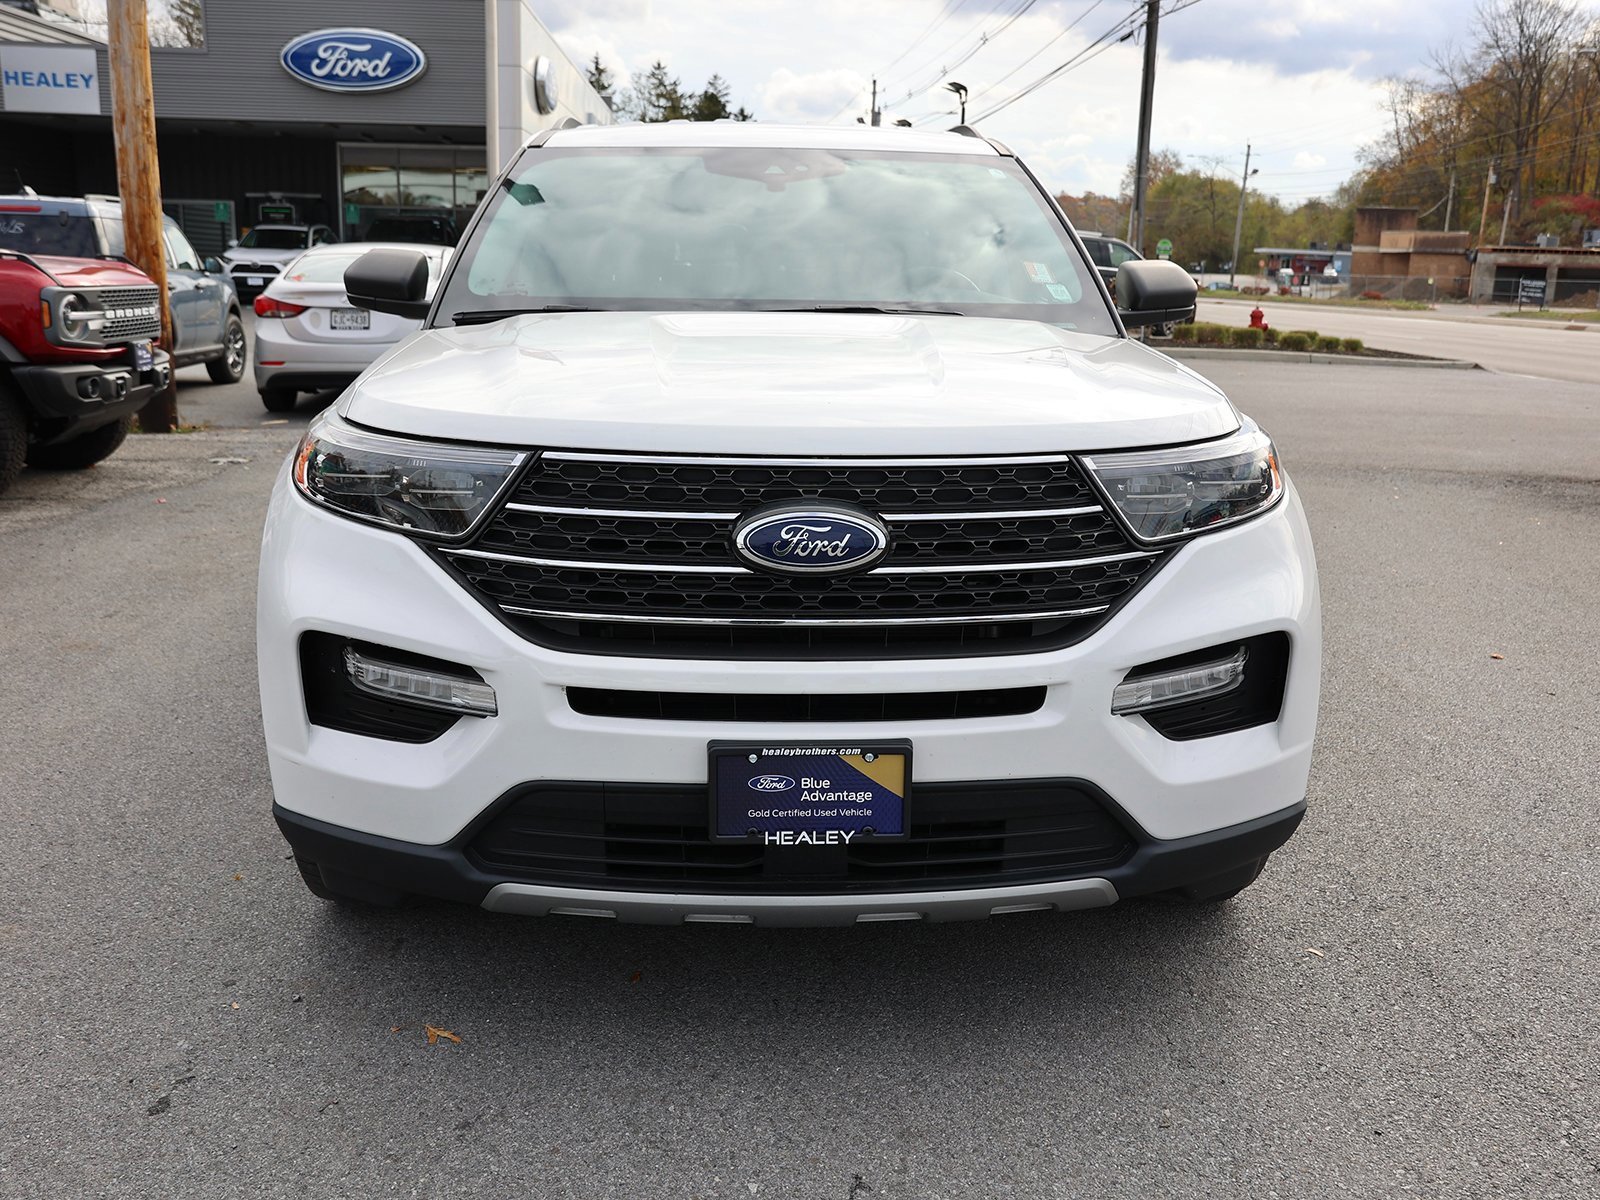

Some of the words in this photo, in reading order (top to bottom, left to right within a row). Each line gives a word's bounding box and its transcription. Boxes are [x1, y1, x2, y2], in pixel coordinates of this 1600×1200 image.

[310, 41, 392, 78] Ford
[4, 70, 94, 89] HEALEY
[105, 306, 156, 319] BRONCO
[772, 524, 851, 557] Ford
[762, 747, 861, 757] healeybrothers.com
[757, 777, 786, 789] Ford
[801, 777, 831, 789] Blue
[800, 790, 873, 803] Advantage
[748, 808, 770, 817] Gold
[772, 808, 812, 818] Certified
[813, 808, 837, 817] Used
[839, 807, 872, 817] Vehicle
[764, 830, 855, 845] HEALEY
